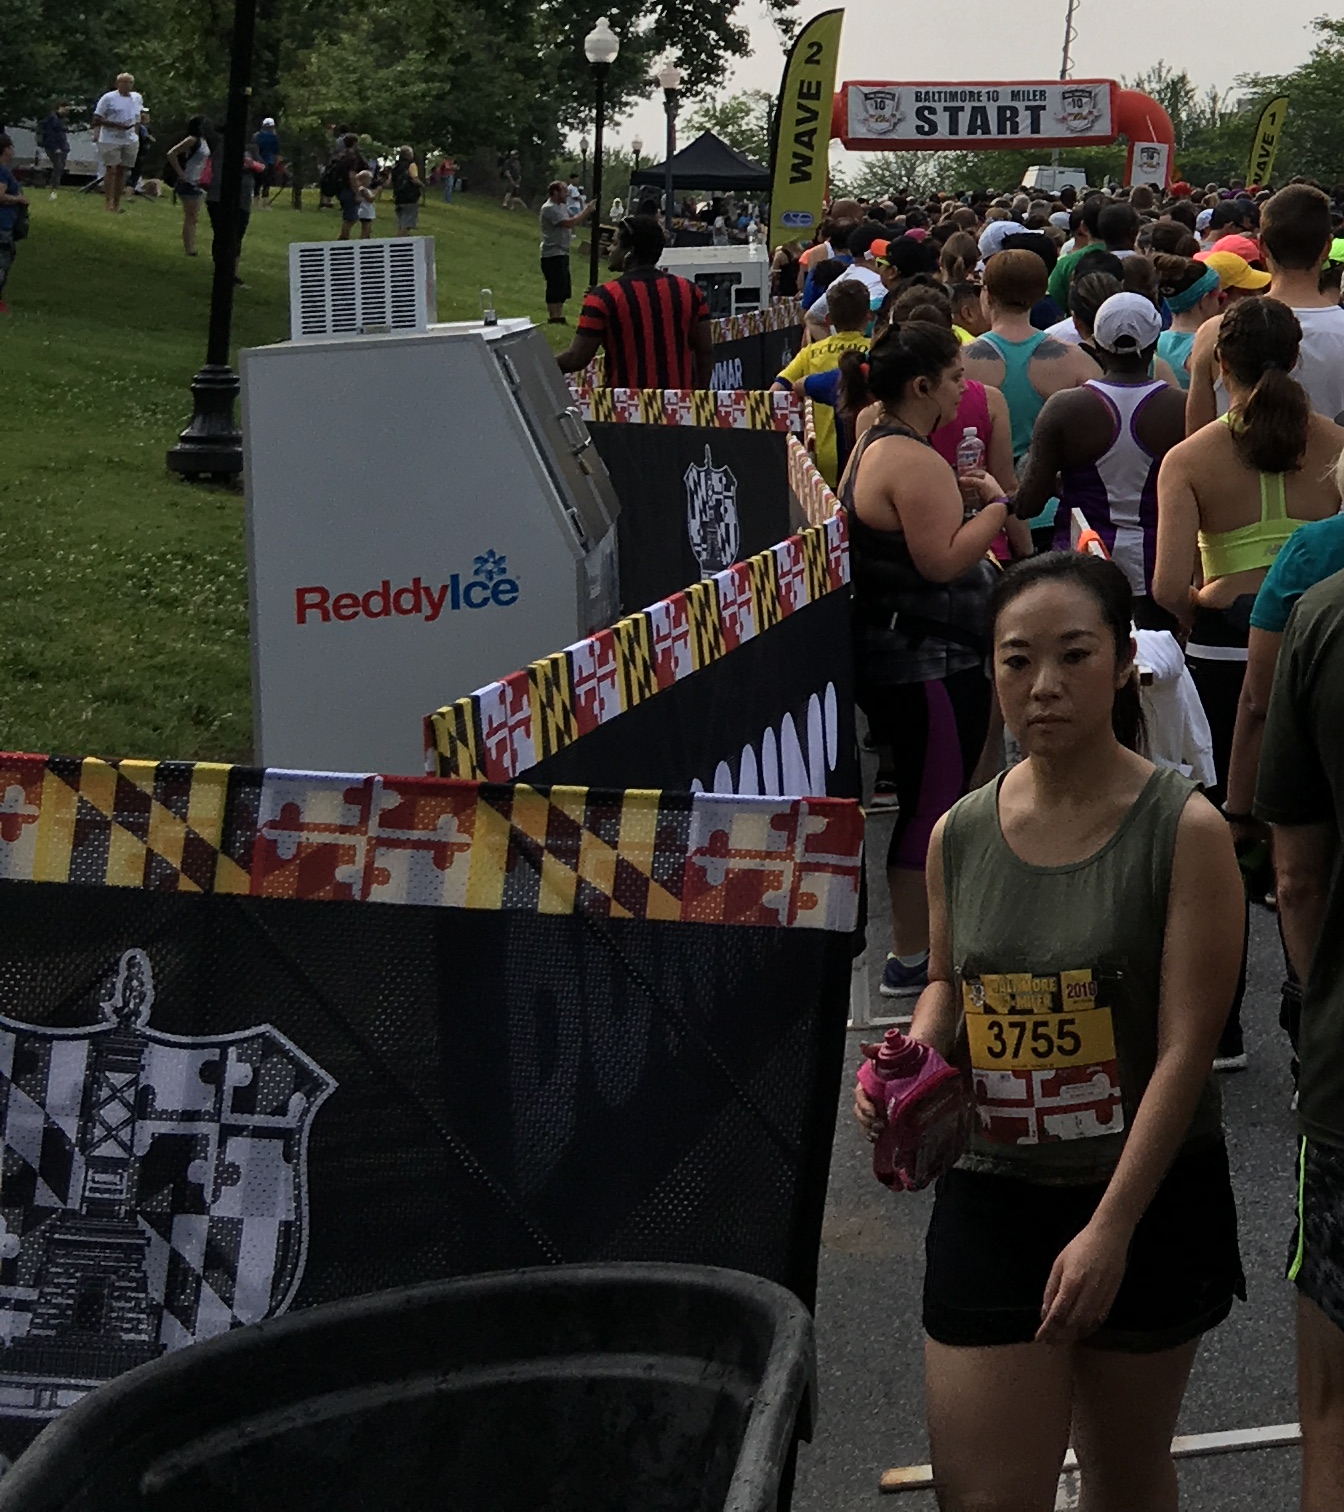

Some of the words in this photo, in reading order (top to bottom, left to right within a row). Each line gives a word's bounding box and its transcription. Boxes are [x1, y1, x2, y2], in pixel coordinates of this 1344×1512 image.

[804, 41, 823, 65] 2
[874, 100, 886, 111] 10
[914, 89, 983, 103] BALTIMORE
[985, 89, 999, 102] 10
[1010, 89, 1047, 102] MILER
[1071, 99, 1083, 110] 10
[789, 80, 822, 184] WAVE
[915, 105, 1047, 136] START
[1253, 132, 1275, 185] WAVE
[1268, 111, 1276, 126] 1
[811, 343, 869, 359] ECUADO
[986, 1018, 1082, 1059] 3755
